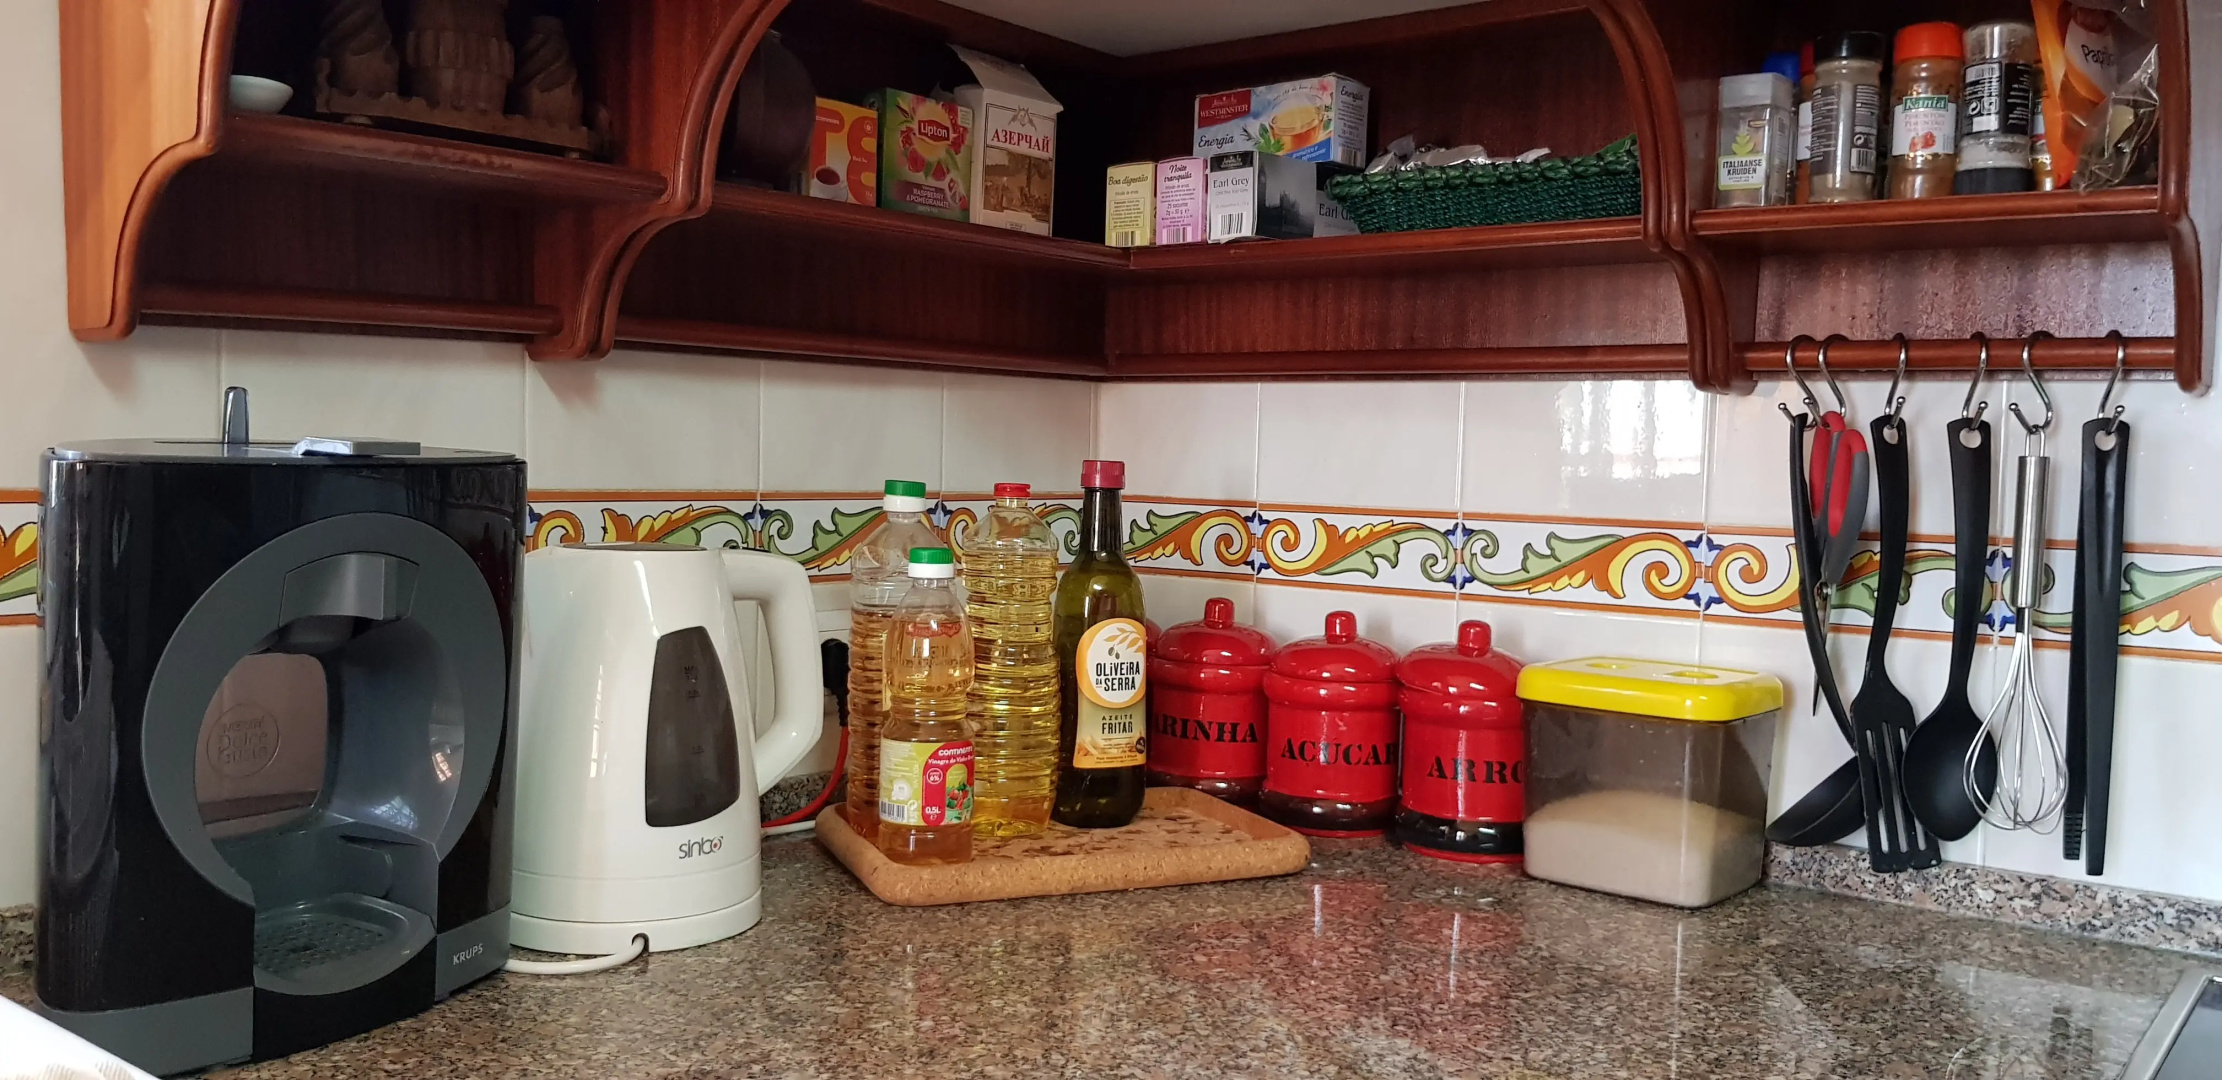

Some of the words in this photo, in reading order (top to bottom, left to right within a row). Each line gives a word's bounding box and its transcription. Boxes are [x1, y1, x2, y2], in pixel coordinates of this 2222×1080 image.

[1905, 98, 1945, 109] Kania
[1200, 104, 1249, 118] WESTMINSTER
[920, 122, 948, 138] Lipton
[991, 128, 1050, 153] АЗЕРЧАЙ
[1198, 133, 1235, 149] Energia
[1722, 159, 1763, 168] ITALIAANSE
[1727, 167, 1757, 176] KRUIDEN
[1108, 176, 1121, 186] Boa
[1213, 178, 1229, 188] Earl
[1231, 177, 1250, 187] Grey
[913, 188, 944, 200] RASPBERRY
[1319, 203, 1338, 219] Earl
[1104, 677, 1136, 692] SERRA
[1102, 721, 1133, 735] FRITAR
[1155, 713, 1258, 743] RINHA
[678, 836, 724, 859] sinbo
[453, 943, 483, 966] KRUPS
